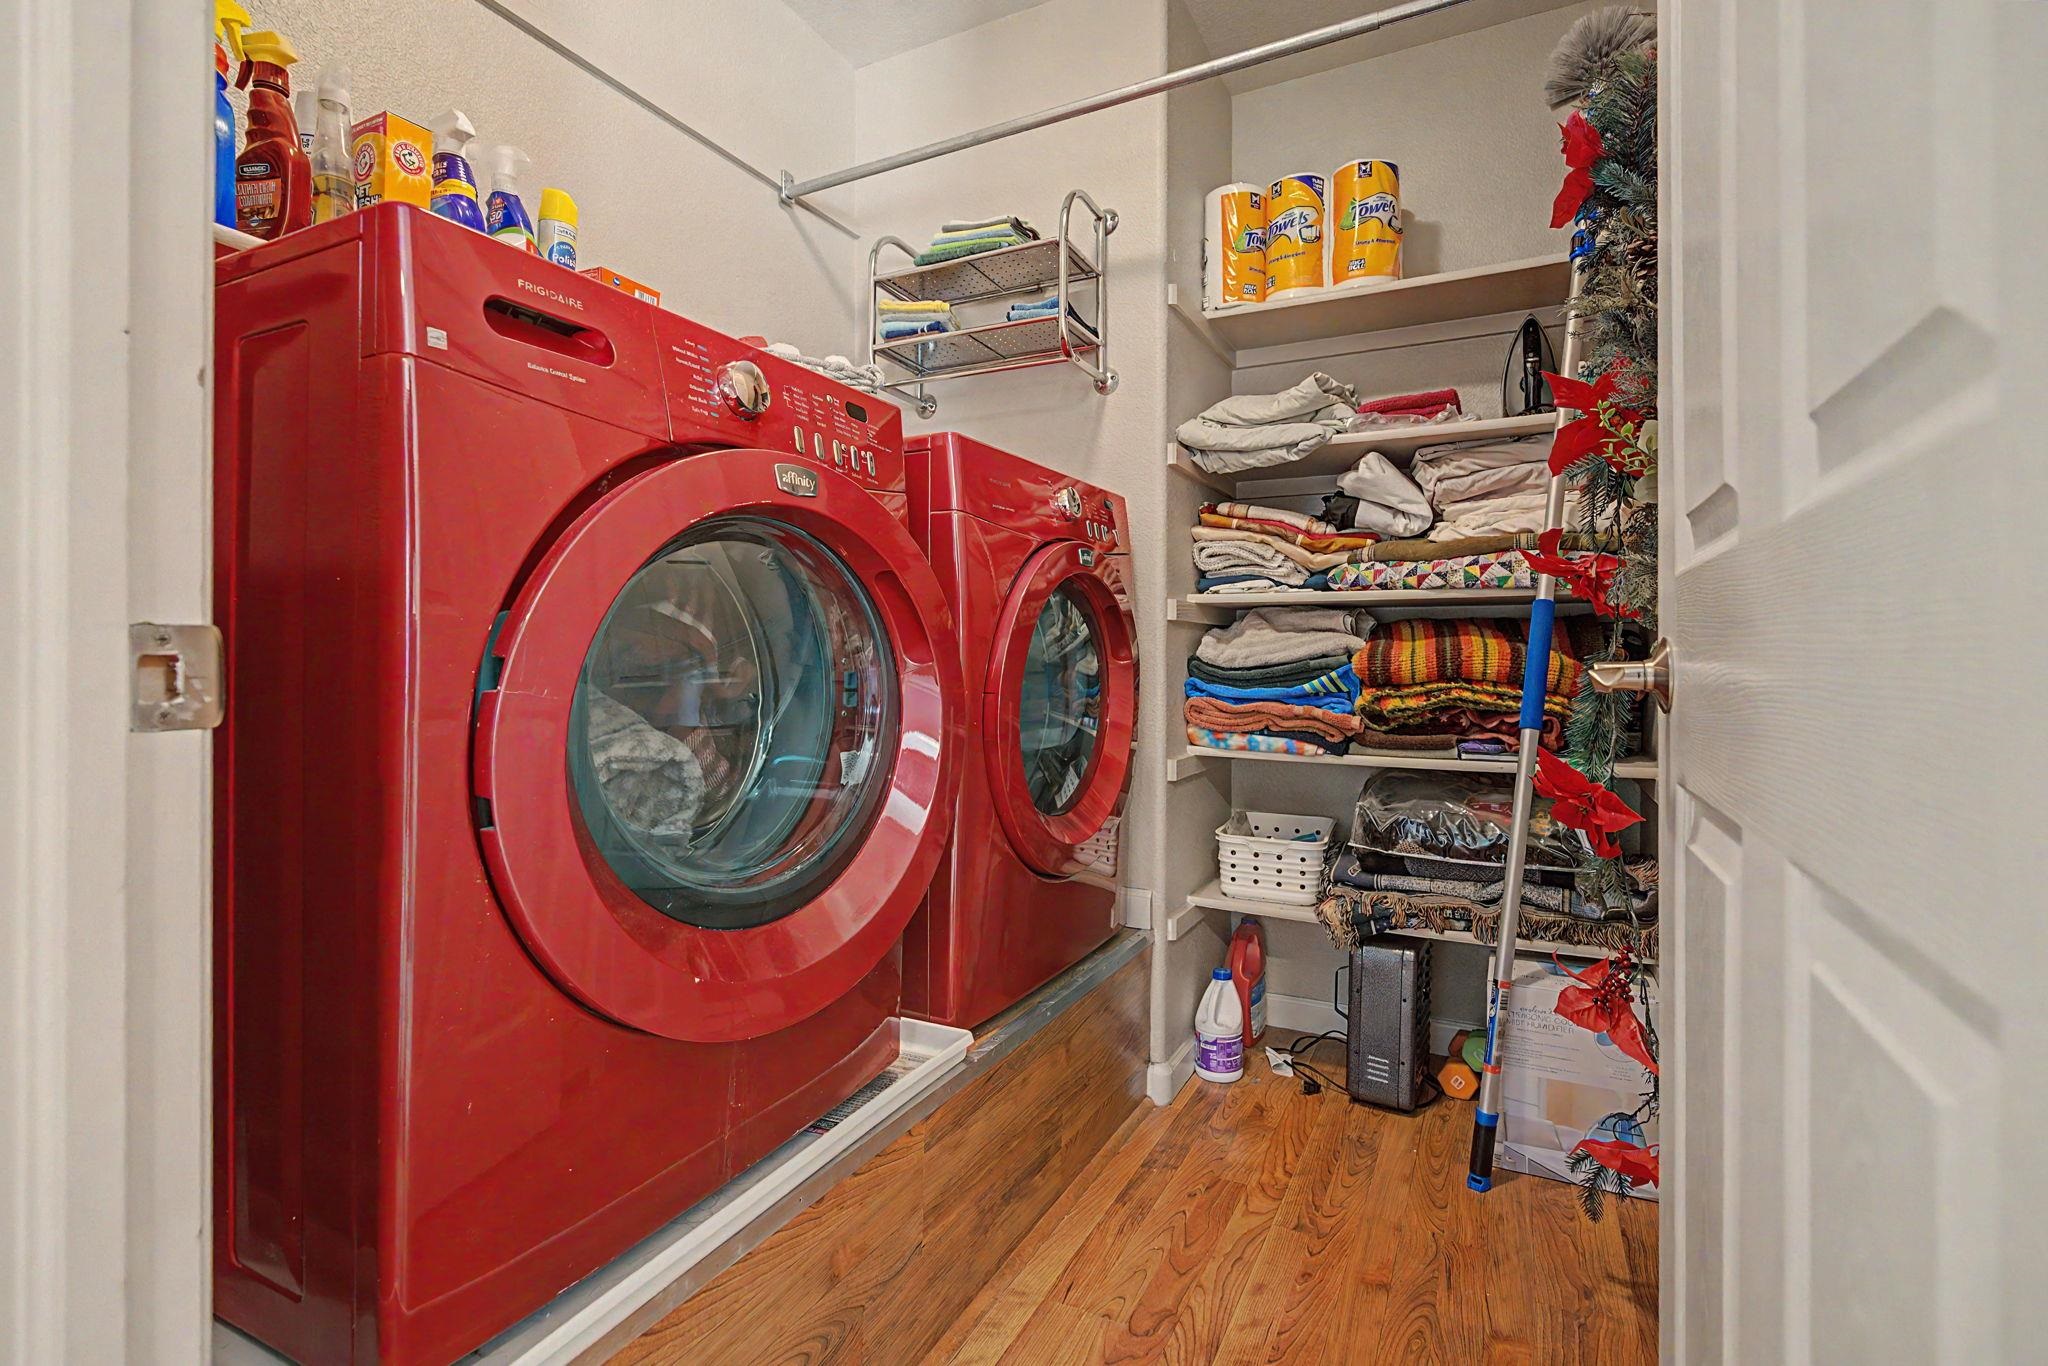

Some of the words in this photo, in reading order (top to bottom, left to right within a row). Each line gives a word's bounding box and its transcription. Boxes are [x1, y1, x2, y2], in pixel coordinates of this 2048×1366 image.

[1350, 200, 1395, 222] Towels
[1268, 211, 1309, 240] Towels
[1245, 232, 1266, 247] Tow
[517, 278, 584, 311] FRIGIDAIRE
[782, 470, 816, 490] affinity
